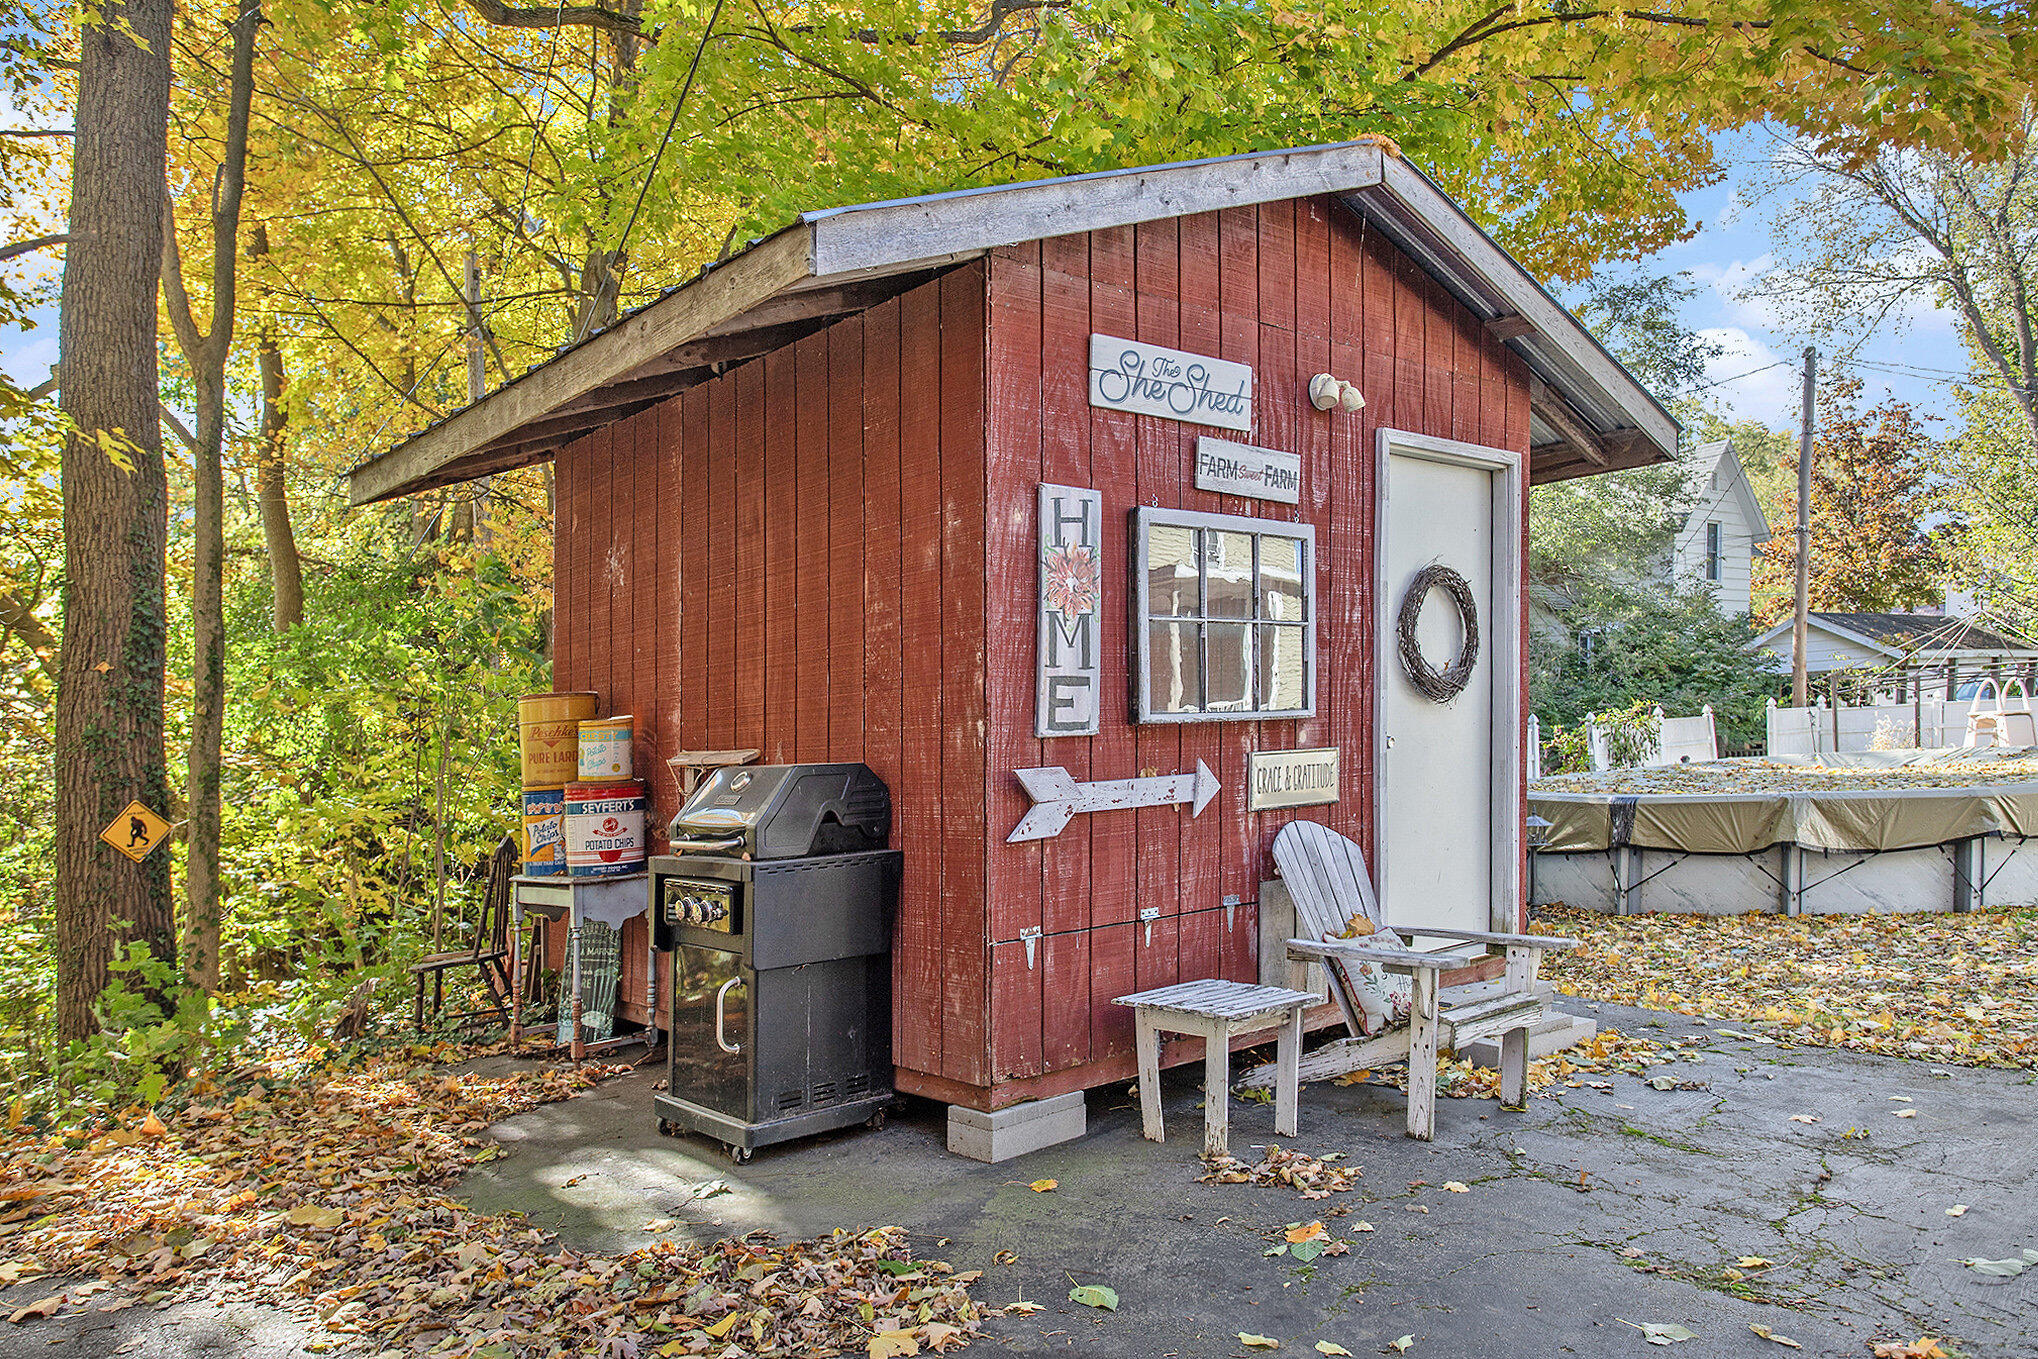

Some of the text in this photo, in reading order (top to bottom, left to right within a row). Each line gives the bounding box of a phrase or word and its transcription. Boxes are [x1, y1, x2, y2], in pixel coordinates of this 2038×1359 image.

[1151, 357, 1181, 378] The
[1099, 350, 1244, 415] She Shed
[1199, 453, 1298, 491] FARM Sweet FARM
[528, 750, 579, 764] PURE LARD
[1257, 762, 1335, 794] GRACE & GRATITUDE
[582, 799, 635, 814] SEYFERT'S
[533, 820, 558, 837] Potato
[536, 829, 559, 845] Chips
[585, 836, 635, 851] POTATO CHIPS
